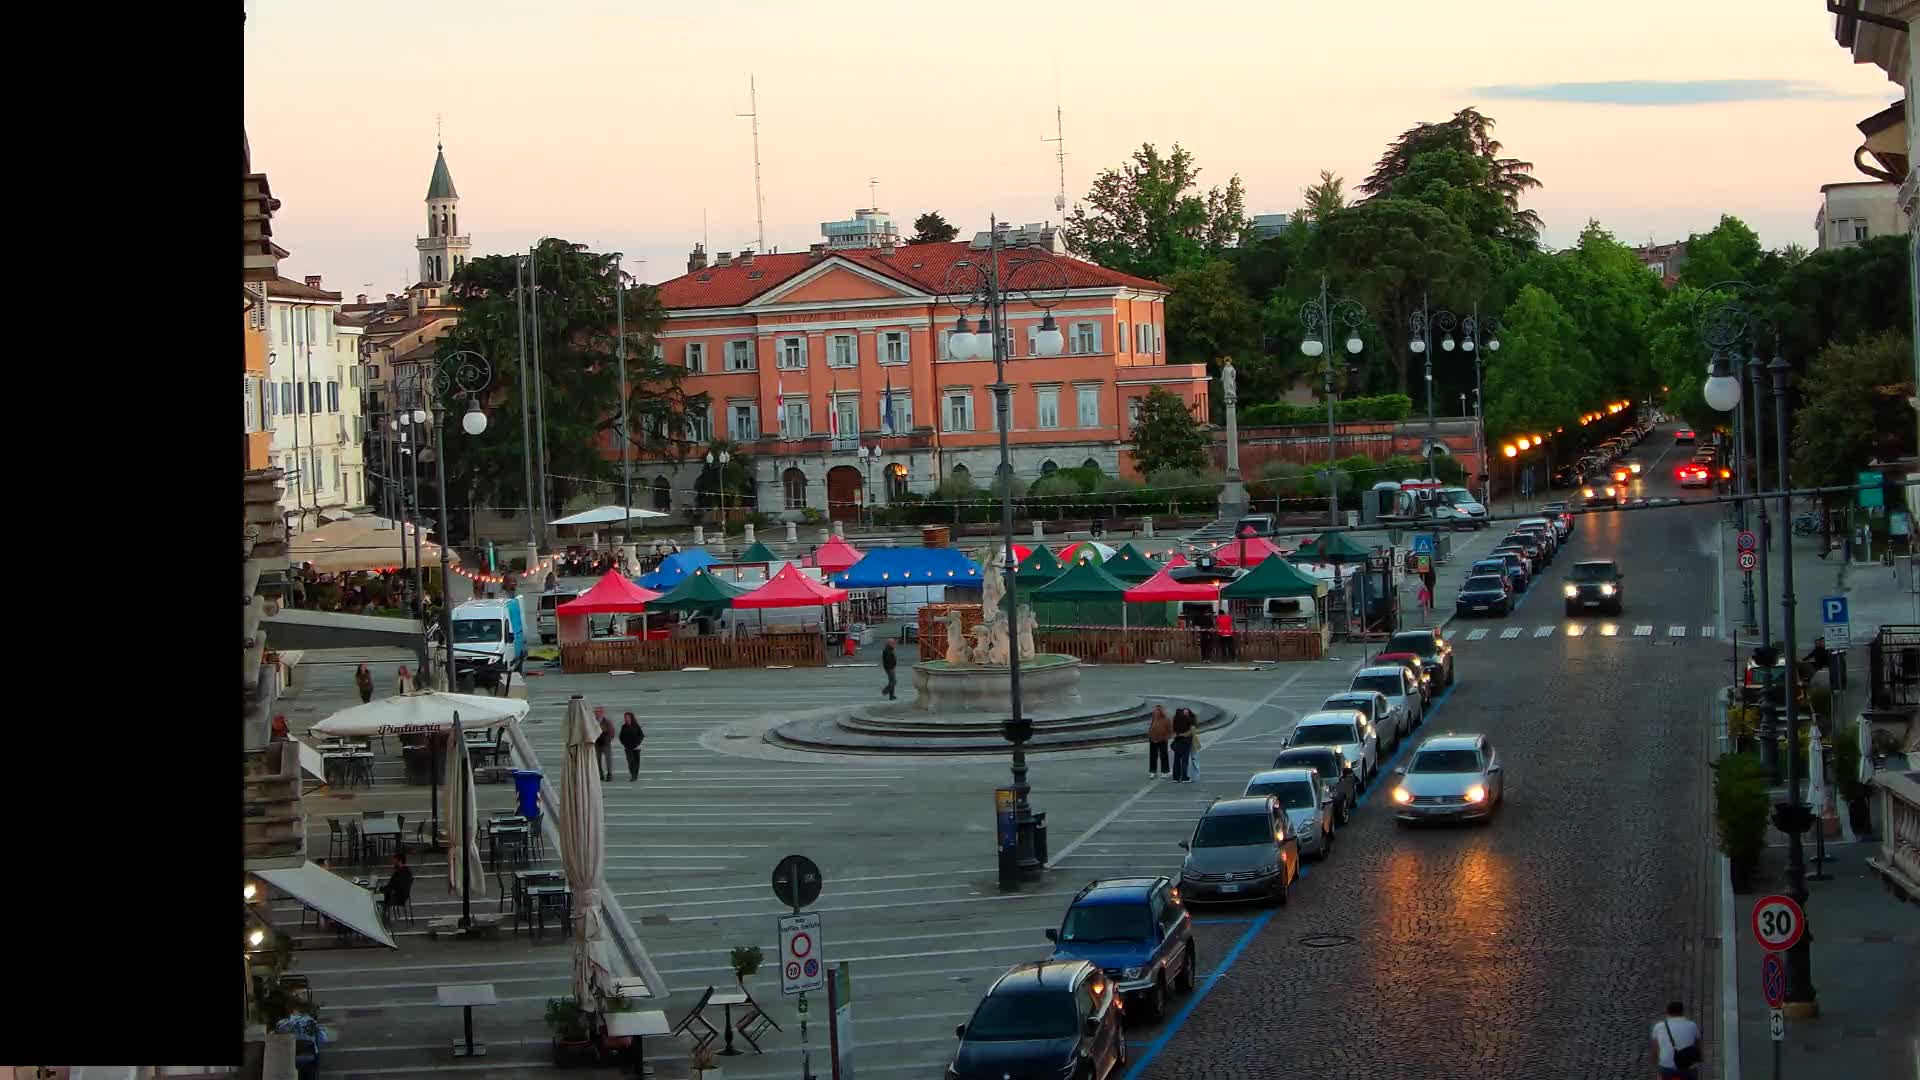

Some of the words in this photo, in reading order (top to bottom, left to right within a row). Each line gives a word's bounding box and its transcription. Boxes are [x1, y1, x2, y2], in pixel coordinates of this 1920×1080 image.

[1743, 557, 1753, 565] 20
[1827, 601, 1842, 620] P
[1762, 910, 1792, 936] 30
